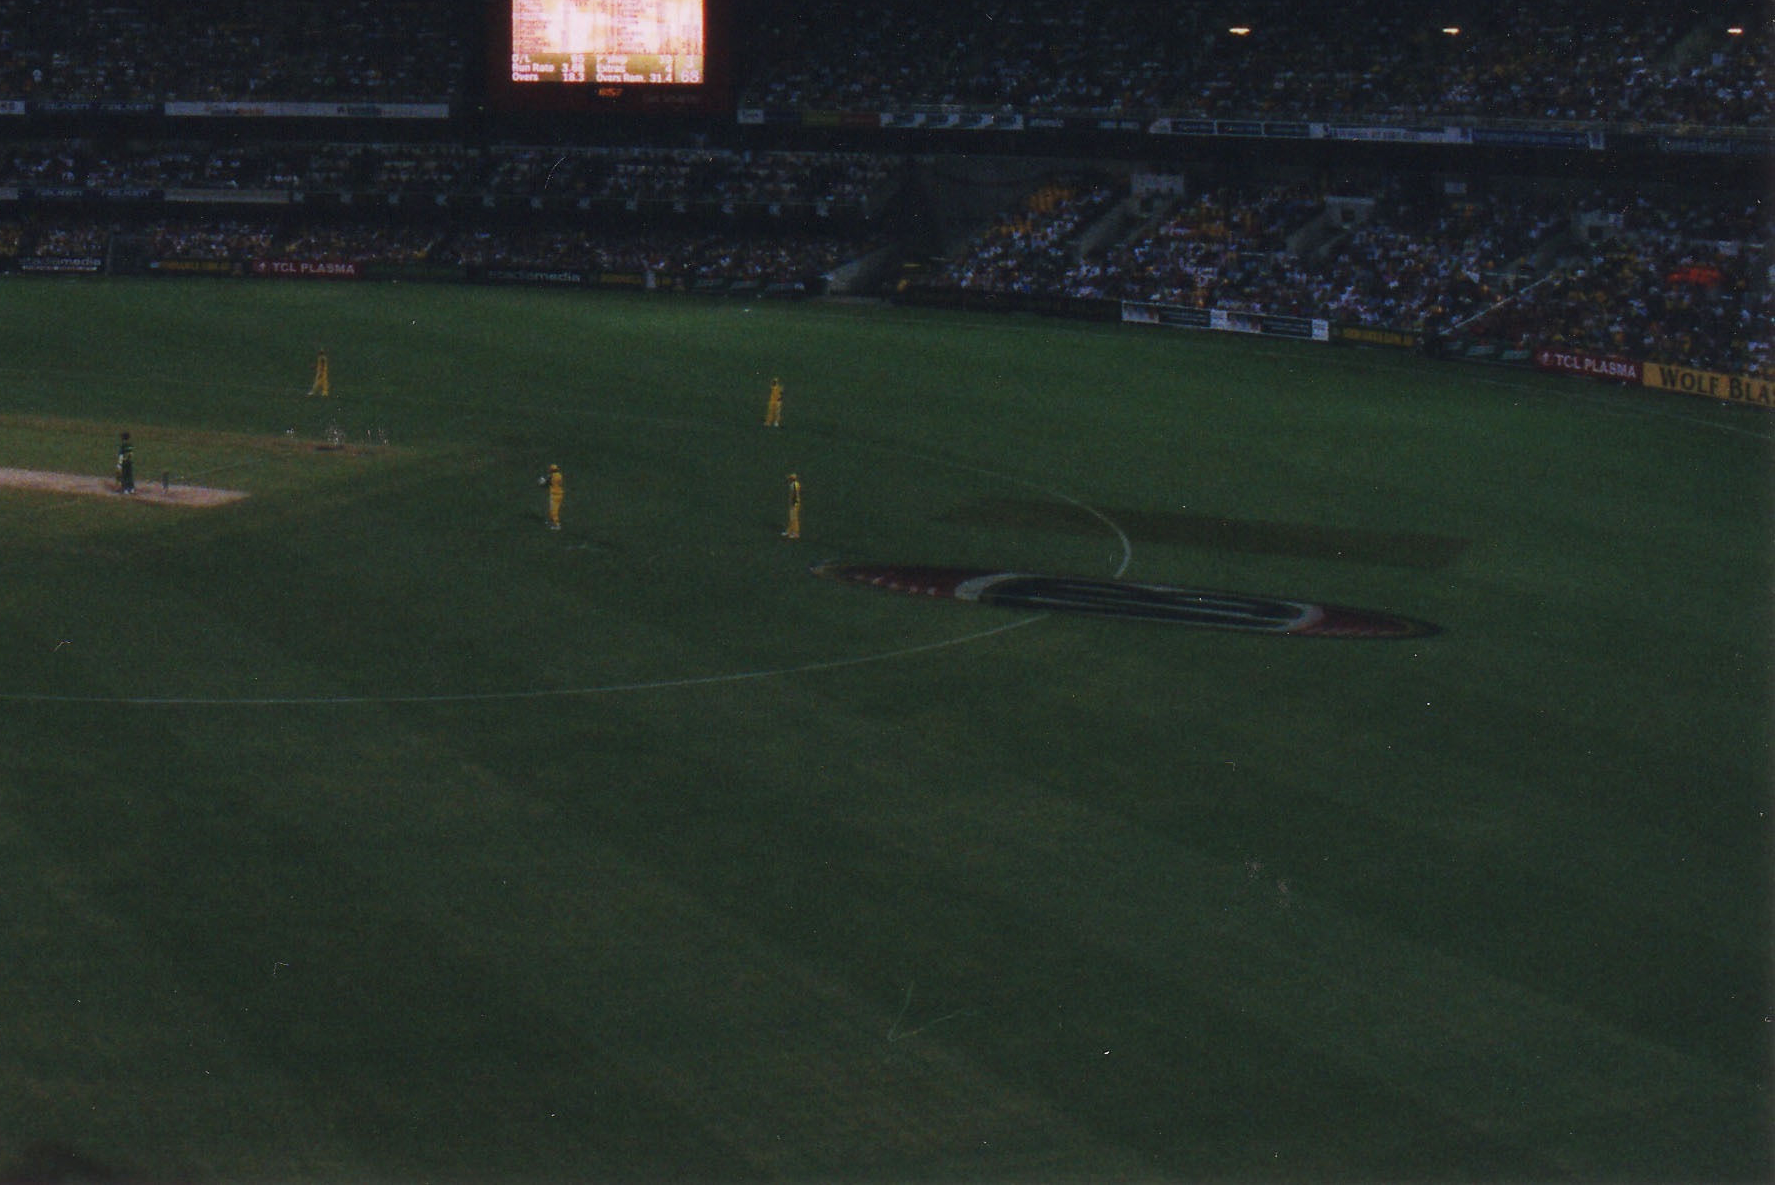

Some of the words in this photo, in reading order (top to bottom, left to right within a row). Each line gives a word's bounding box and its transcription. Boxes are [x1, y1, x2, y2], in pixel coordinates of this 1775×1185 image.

[512, 63, 531, 72] Run
[532, 63, 554, 72] Rate
[512, 72, 538, 81] Overs
[562, 72, 585, 81] 18.3
[596, 72, 622, 82] Overs
[649, 72, 673, 82] 31.4
[680, 70, 699, 82] 68
[272, 263, 296, 273] TCL
[300, 263, 355, 275] PLASMA
[1556, 354, 1580, 370] TCL
[1585, 358, 1636, 378] PLASMA
[1660, 366, 1720, 396] WOLF
[1729, 377, 1775, 407] BLA
